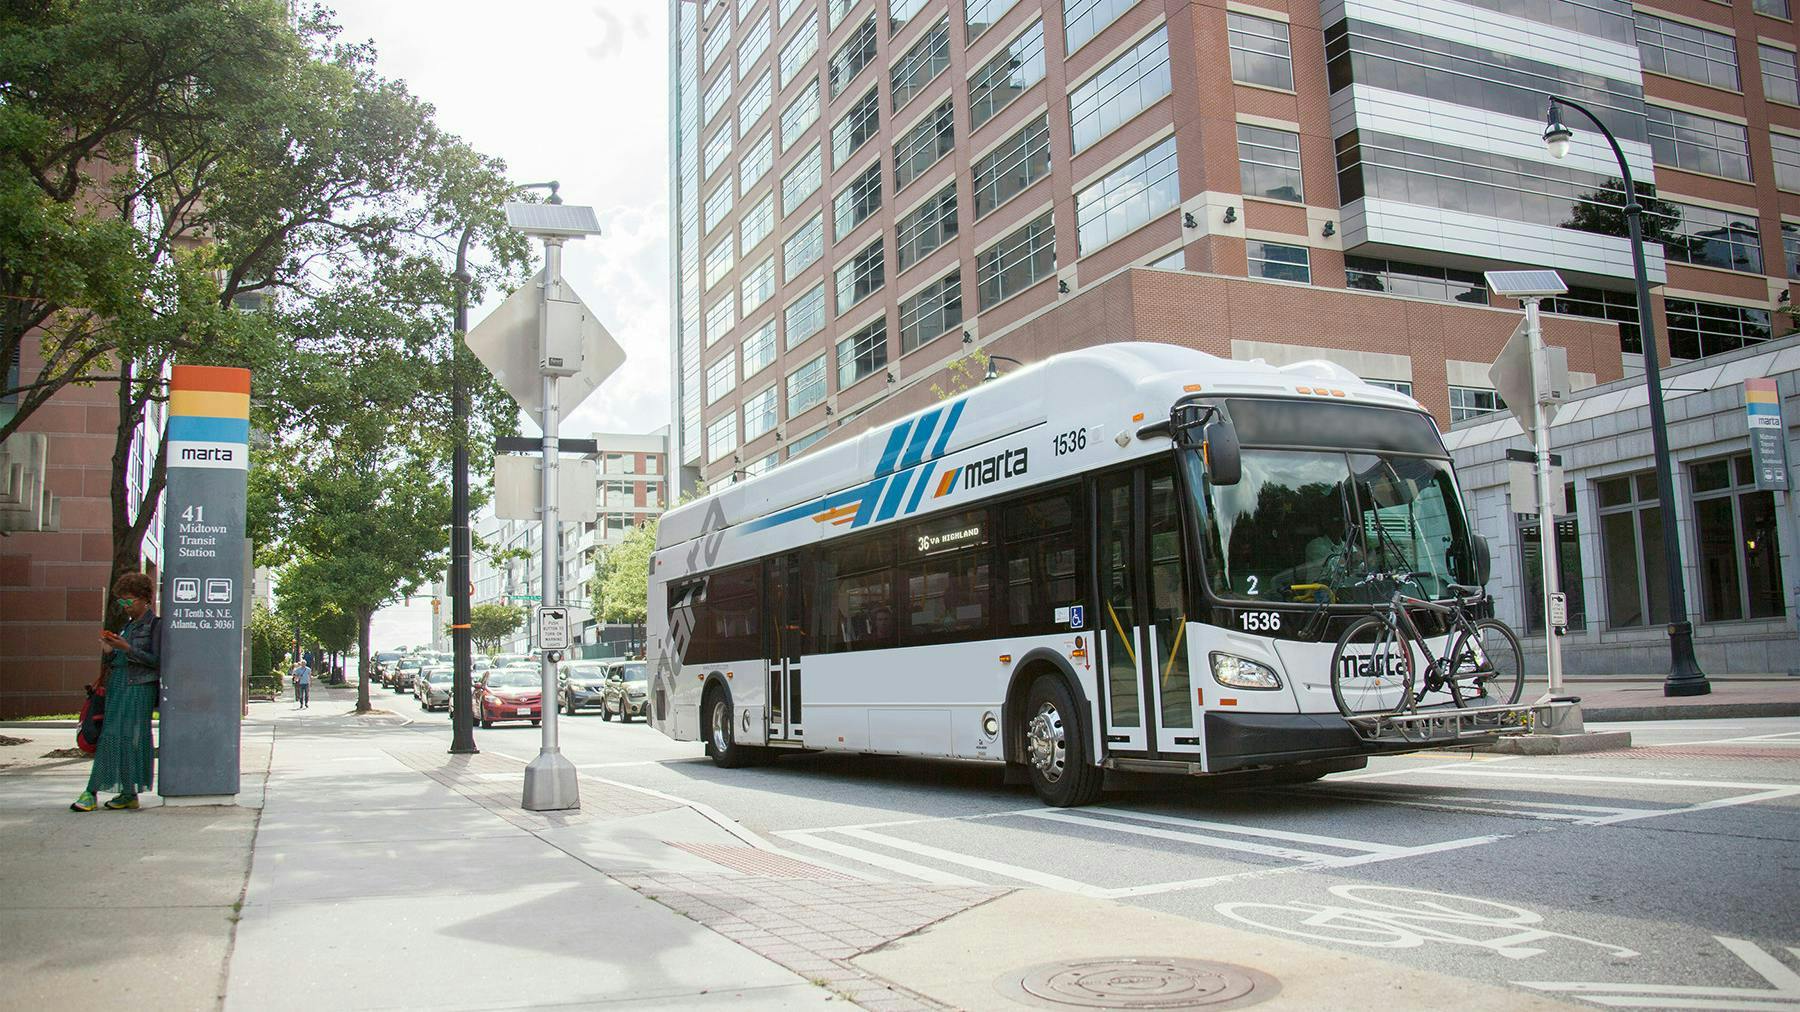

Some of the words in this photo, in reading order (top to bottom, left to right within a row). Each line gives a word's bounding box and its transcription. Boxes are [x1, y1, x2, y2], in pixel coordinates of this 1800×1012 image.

[1053, 427, 1087, 457] 1536
[182, 448, 233, 461] marta
[964, 447, 1028, 490] marta
[182, 505, 204, 522] 41
[179, 523, 227, 534] Midtown
[179, 535, 216, 546] Transit
[918, 535, 930, 552] 36
[930, 537, 940, 545] VA
[942, 527, 979, 543] HIGHLAND
[179, 547, 216, 557] Station
[1246, 575, 1259, 595] 2
[173, 608, 182, 618] 41
[184, 608, 204, 618] Tenth
[205, 608, 215, 618] St.
[216, 608, 233, 618] N.E.
[170, 619, 198, 630] Atlanta,
[199, 619, 212, 629] Ga.
[213, 619, 235, 630] 30361
[1240, 612, 1281, 631] 1536
